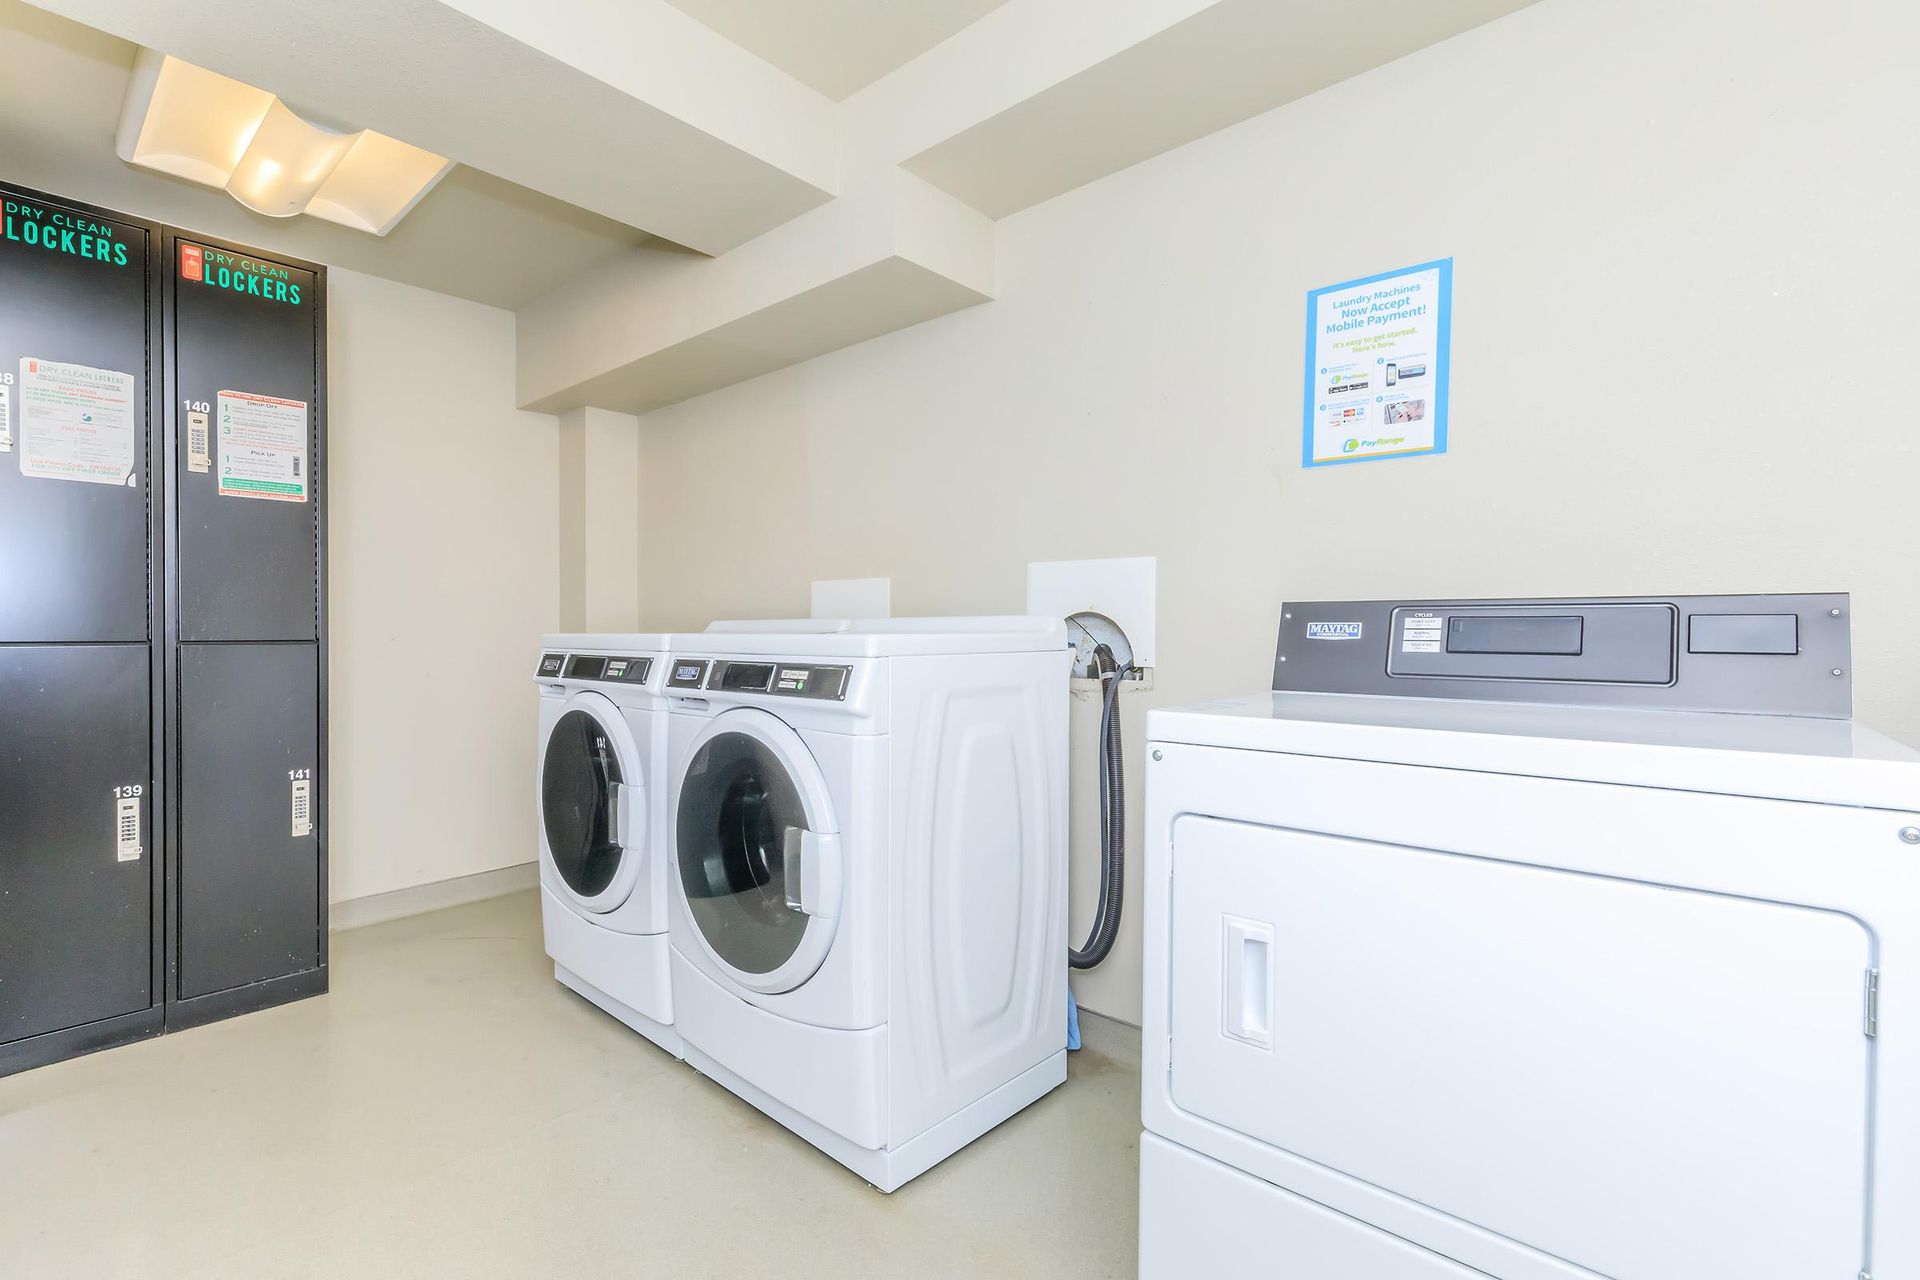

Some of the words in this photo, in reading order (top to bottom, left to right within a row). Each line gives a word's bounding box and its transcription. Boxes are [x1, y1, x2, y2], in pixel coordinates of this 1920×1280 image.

[6, 202, 43, 219] DRY
[53, 214, 112, 237] CLEAN
[7, 215, 127, 265] LOCKERS
[204, 250, 234, 265] DRY
[241, 260, 288, 280] CLEAN
[205, 263, 300, 305] LOCKERS
[1333, 294, 1372, 309] Laundry
[1374, 283, 1421, 300] Machines
[1341, 306, 1368, 319] Now
[1370, 296, 1411, 313] Accept
[1326, 317, 1364, 334] Mobile
[1367, 304, 1427, 326] Payment!
[1333, 339, 1344, 349] It's
[1346, 338, 1363, 348] easy
[1364, 335, 1373, 343] to
[1373, 333, 1387, 344] get
[1388, 327, 1418, 340] started.
[1352, 343, 1376, 354] Here's
[40, 365, 60, 374] DRY
[61, 368, 93, 380] CLEAN
[183, 399, 210, 414] 140
[223, 415, 231, 423] 2
[223, 427, 231, 435] 3
[1361, 436, 1406, 448] PayRange
[1310, 624, 1359, 633] MAYTAG
[288, 769, 311, 781] 141
[113, 785, 143, 798] 139
